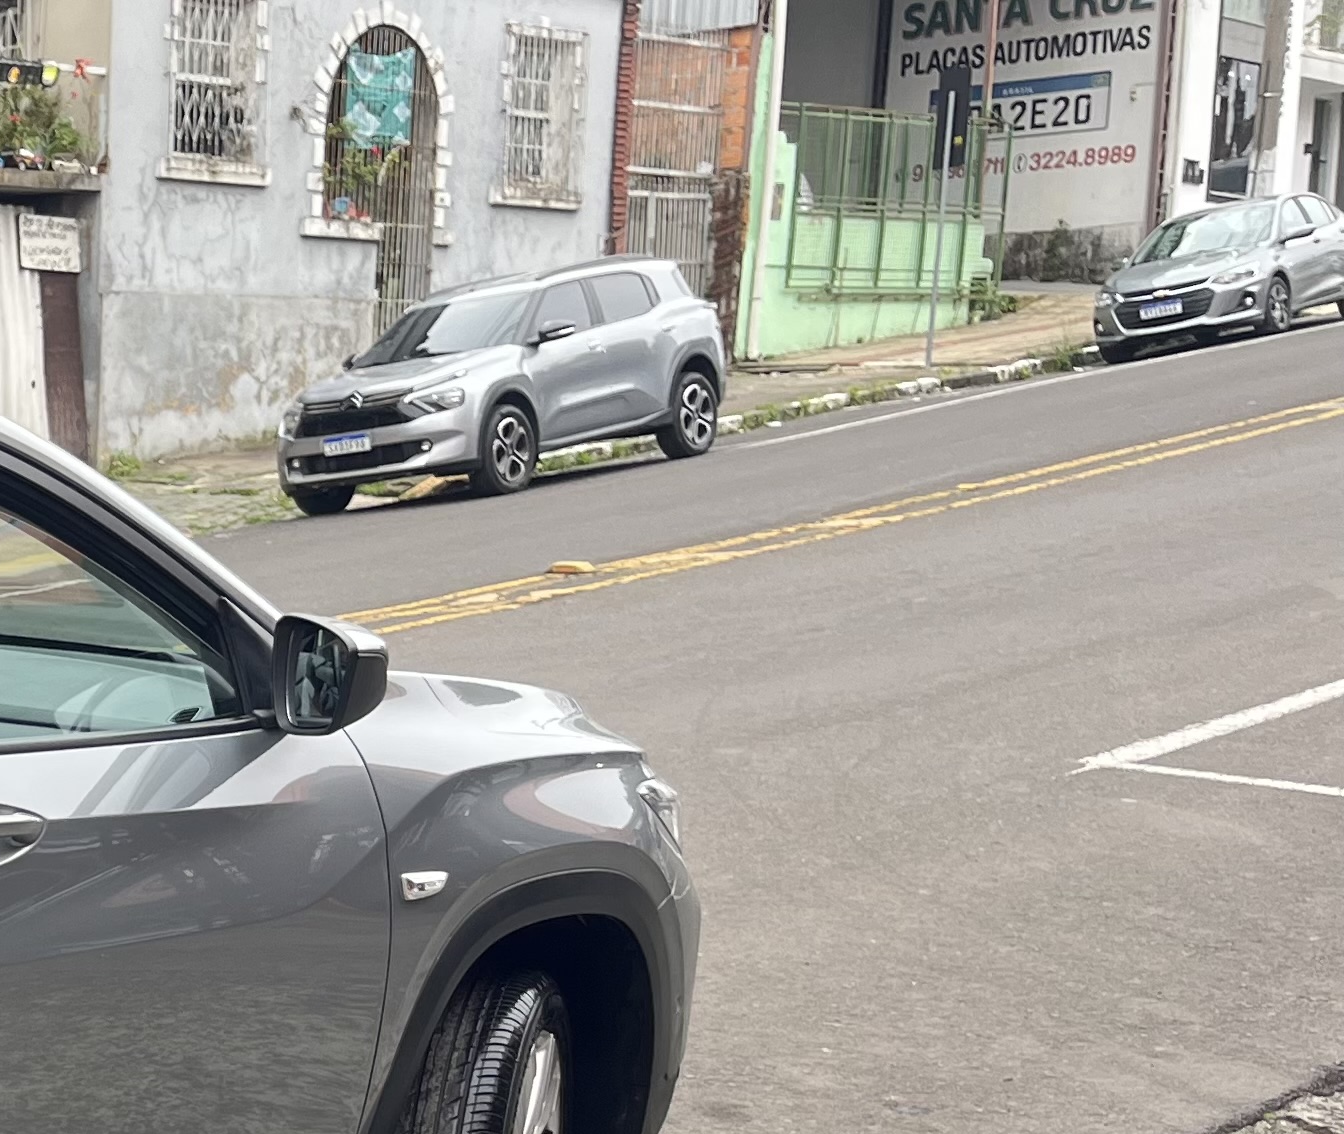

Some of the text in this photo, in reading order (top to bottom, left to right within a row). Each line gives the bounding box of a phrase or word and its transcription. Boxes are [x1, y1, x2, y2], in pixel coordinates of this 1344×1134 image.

[1049, 0, 1154, 20] CR
[900, 25, 1152, 77] PLACAS AUTOMOTIVAS
[1028, 144, 1137, 171] 3224.8989
